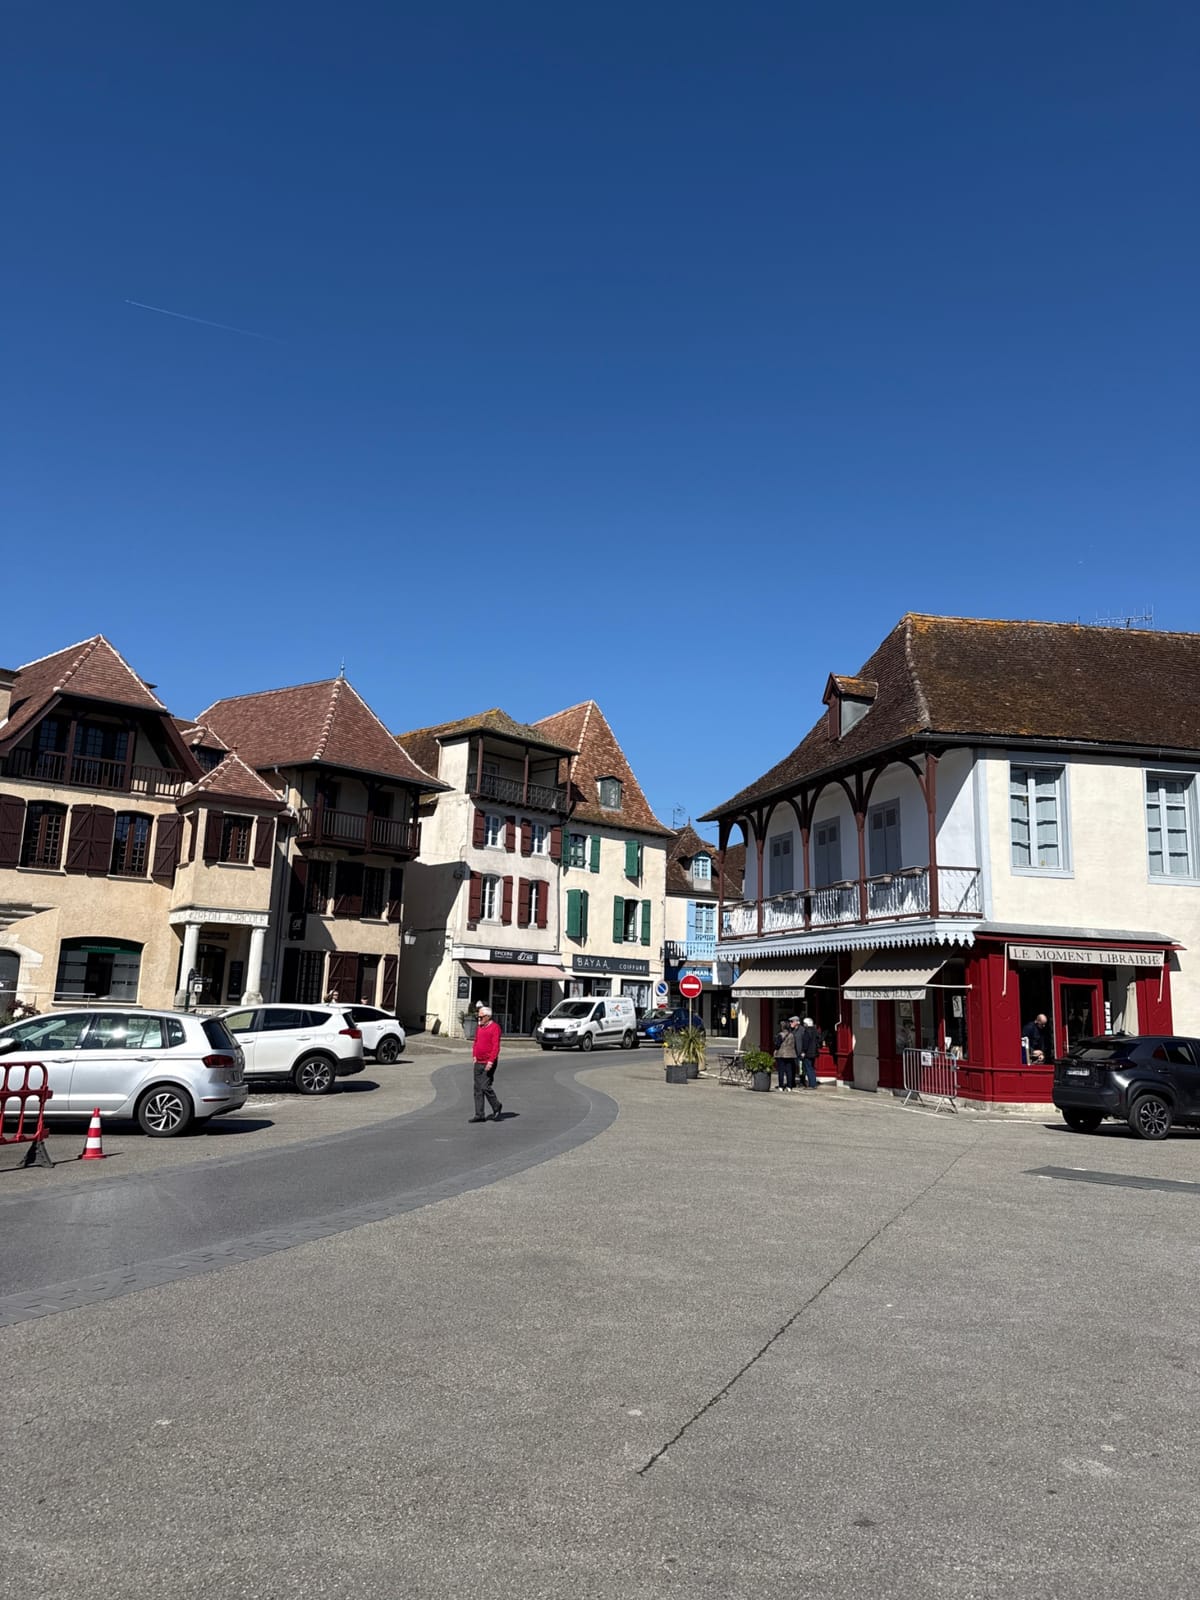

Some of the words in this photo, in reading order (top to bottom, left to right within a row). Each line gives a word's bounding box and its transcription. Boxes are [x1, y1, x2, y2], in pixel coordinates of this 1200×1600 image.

[576, 957, 611, 970] BAYAA
[1013, 948, 1030, 959] LE
[1035, 949, 1093, 962] MOMENT
[1099, 952, 1161, 965] LIBRAIRIE
